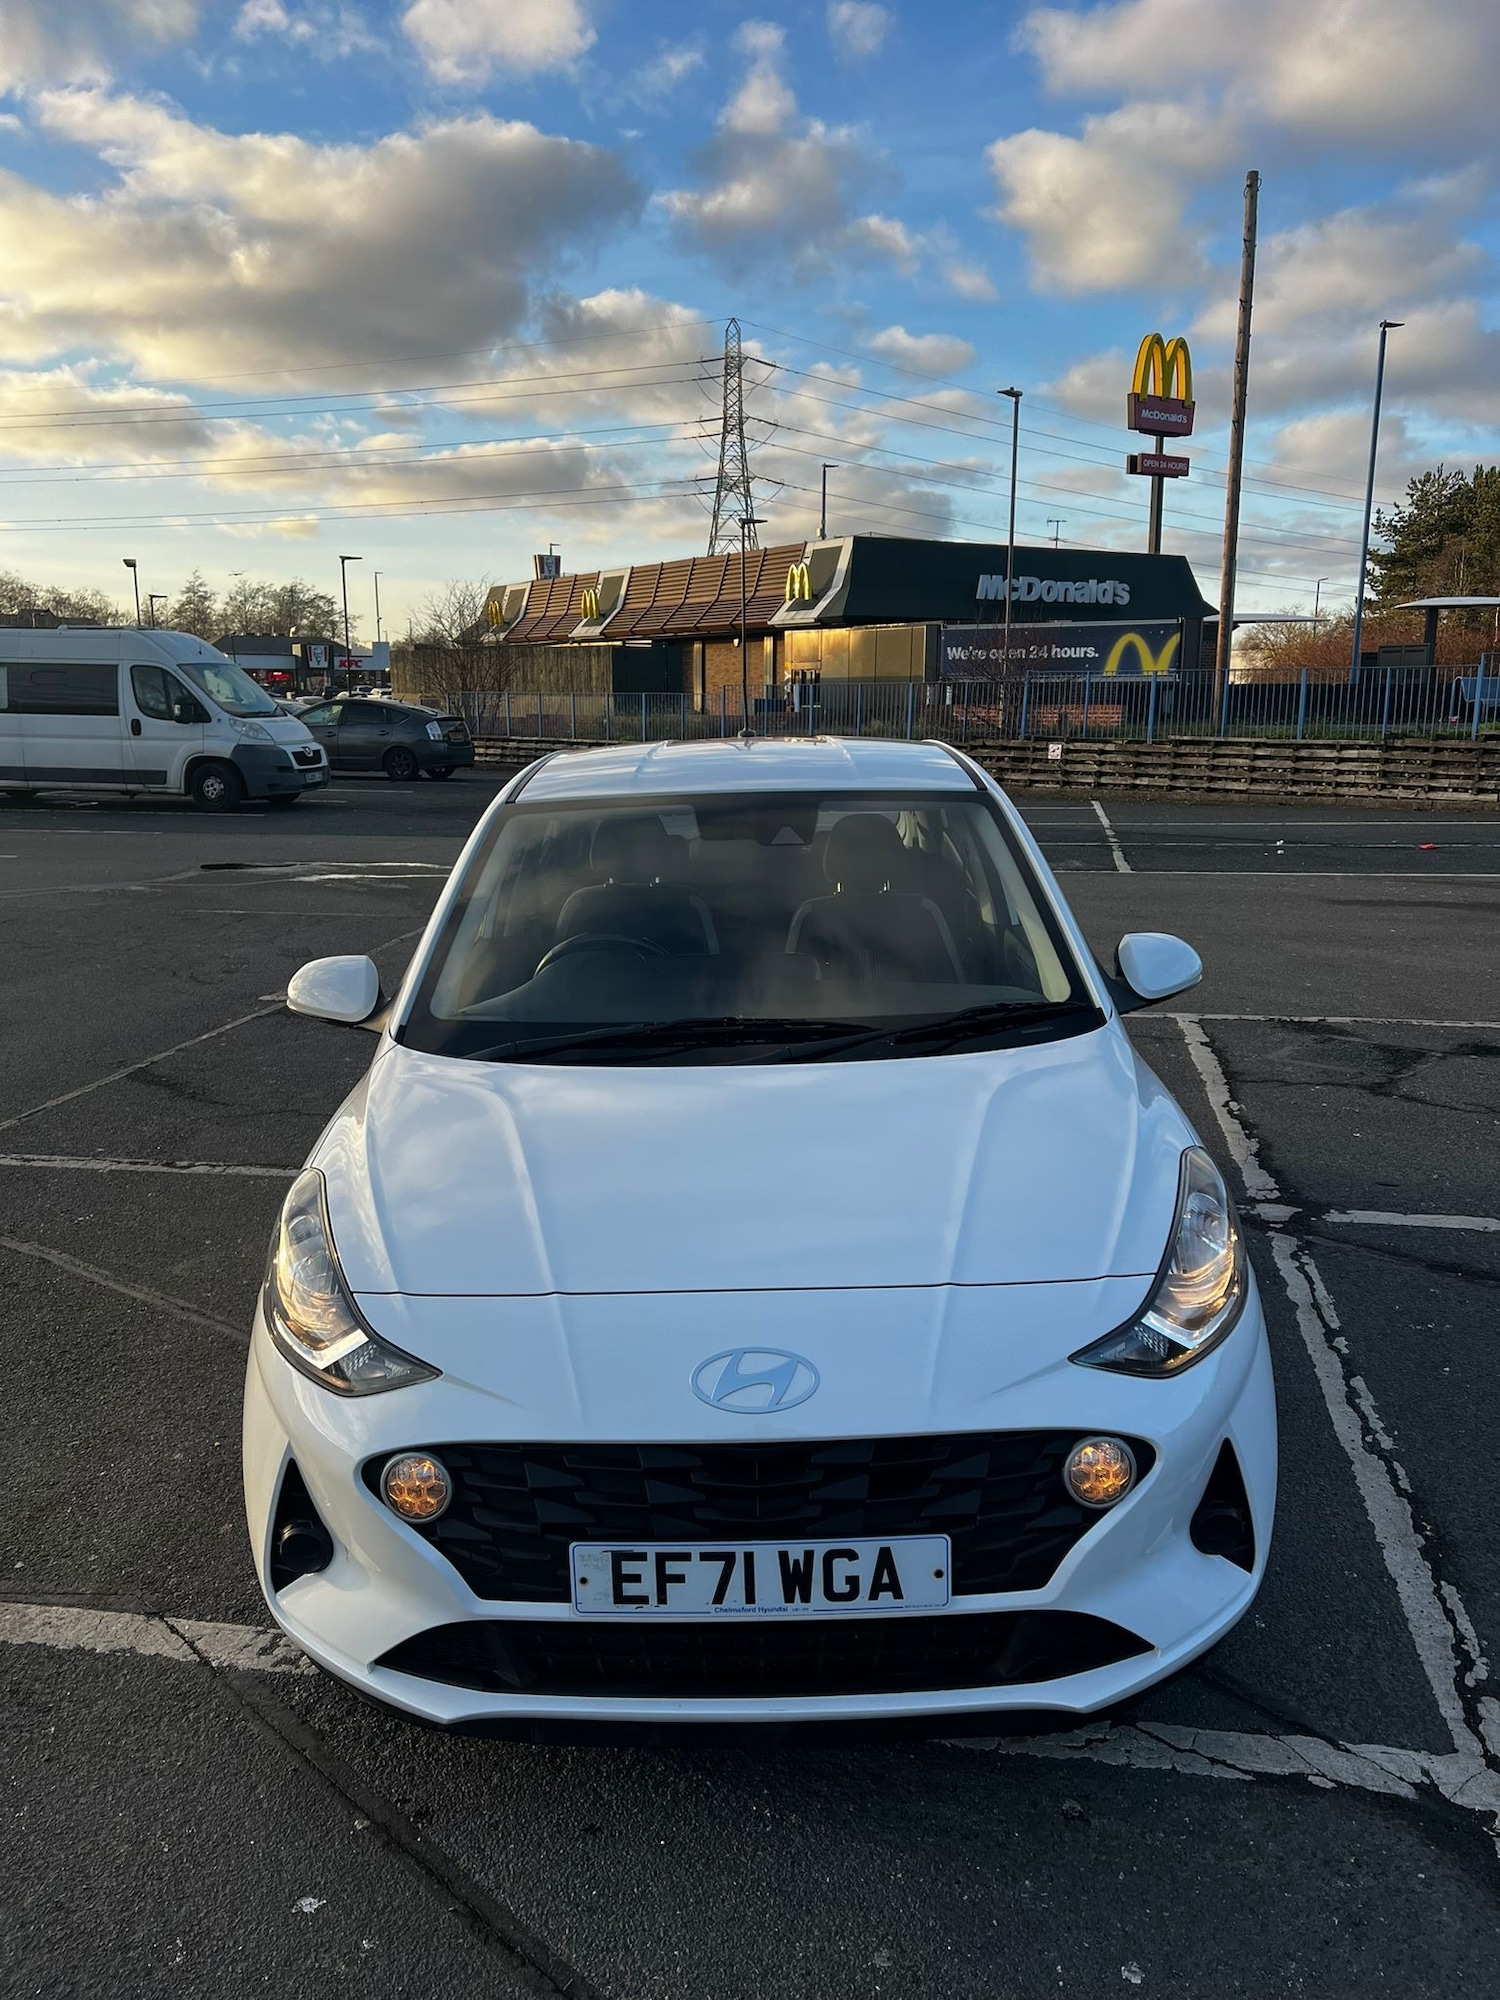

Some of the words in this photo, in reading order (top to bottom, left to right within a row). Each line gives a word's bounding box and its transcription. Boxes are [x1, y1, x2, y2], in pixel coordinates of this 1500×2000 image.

[1141, 409, 1188, 424] McDonald's
[1143, 459, 1159, 468] OPEN
[1160, 461, 1167, 469] 24
[1168, 462, 1188, 471] HOURS
[976, 574, 1130, 605] McDonald's
[946, 646, 986, 660] We're
[1051, 644, 1099, 659] hours.
[338, 659, 362, 669] KFC
[611, 1551, 757, 1605] EF71
[778, 1546, 905, 1603] WGA
[714, 1606, 757, 1614] Chelmsford
[758, 1605, 788, 1614] Hyundai
